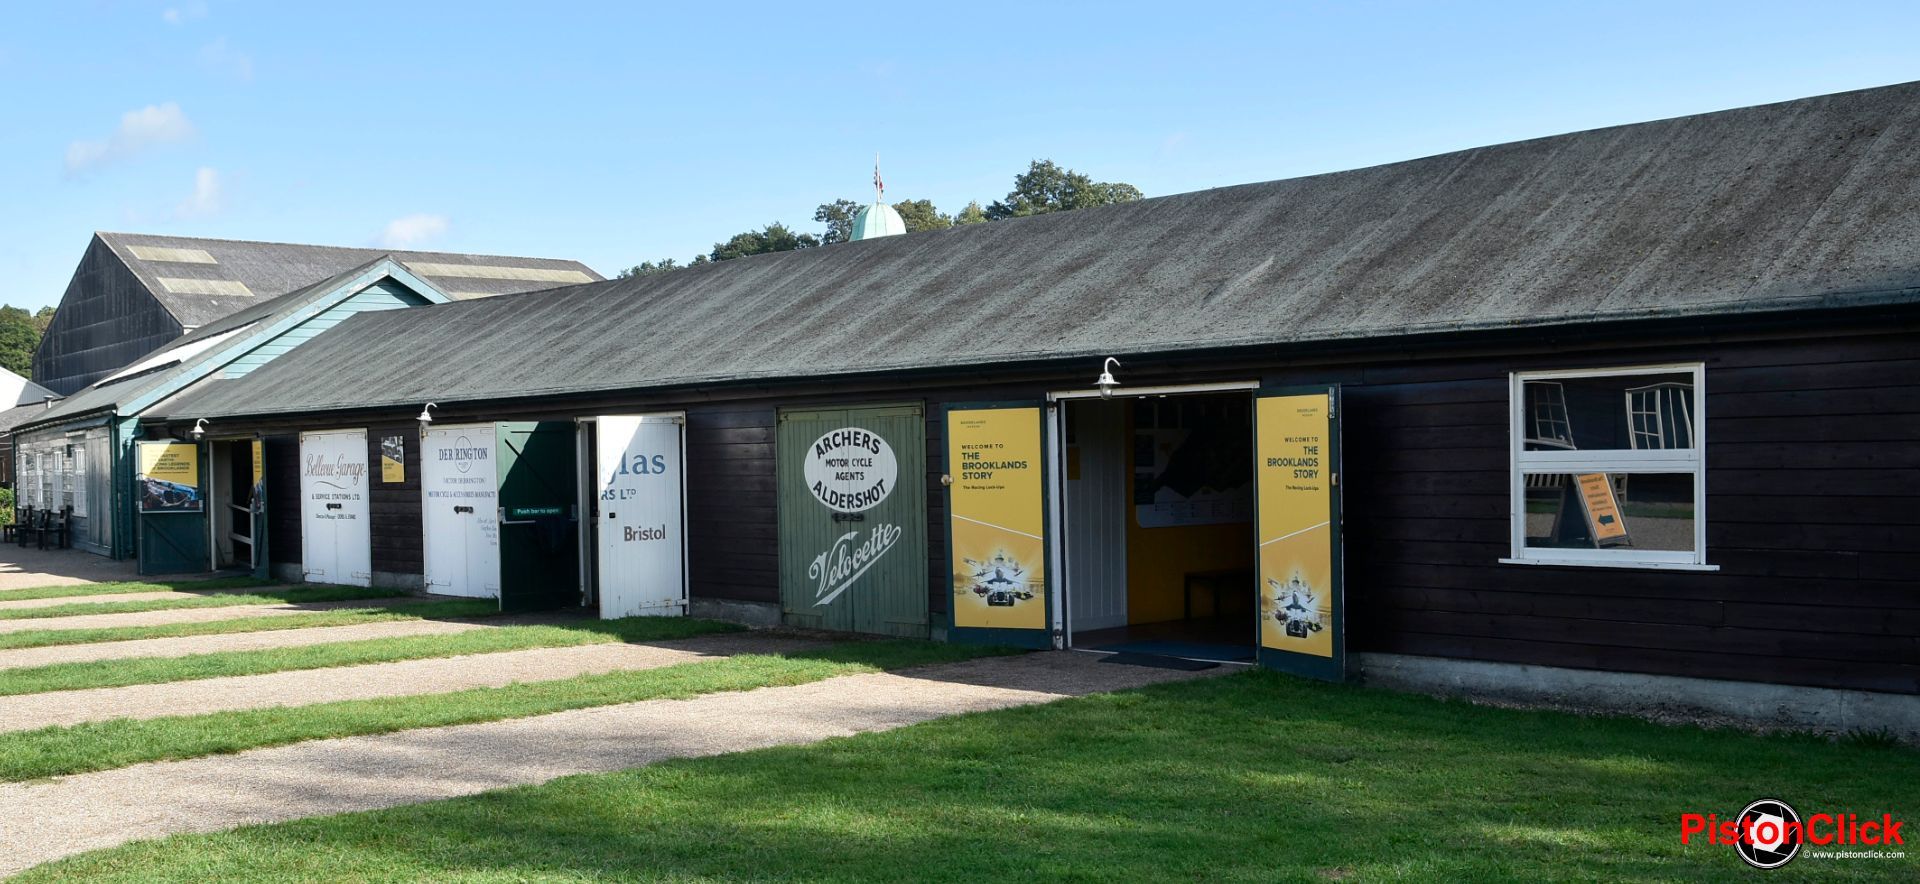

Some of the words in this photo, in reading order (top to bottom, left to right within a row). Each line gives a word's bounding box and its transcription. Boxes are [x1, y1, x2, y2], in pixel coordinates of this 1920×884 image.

[816, 430, 880, 459] ARCHERS
[1303, 446, 1318, 455] THE
[962, 452, 980, 460] THE
[826, 458, 850, 468] MOTOR
[852, 458, 872, 467] CYCLE
[962, 461, 1028, 470] BROOKLANDS
[1267, 458, 1318, 467] BROOKLANDS
[304, 454, 334, 476] Bellevue
[336, 453, 365, 486] Garage
[1294, 470, 1318, 478] STORY
[835, 472, 864, 480] AGENTS
[962, 472, 992, 480] STORY
[813, 478, 886, 509] ALDERSHOT
[624, 524, 666, 542] Bristol
[809, 524, 901, 600] Velocette
